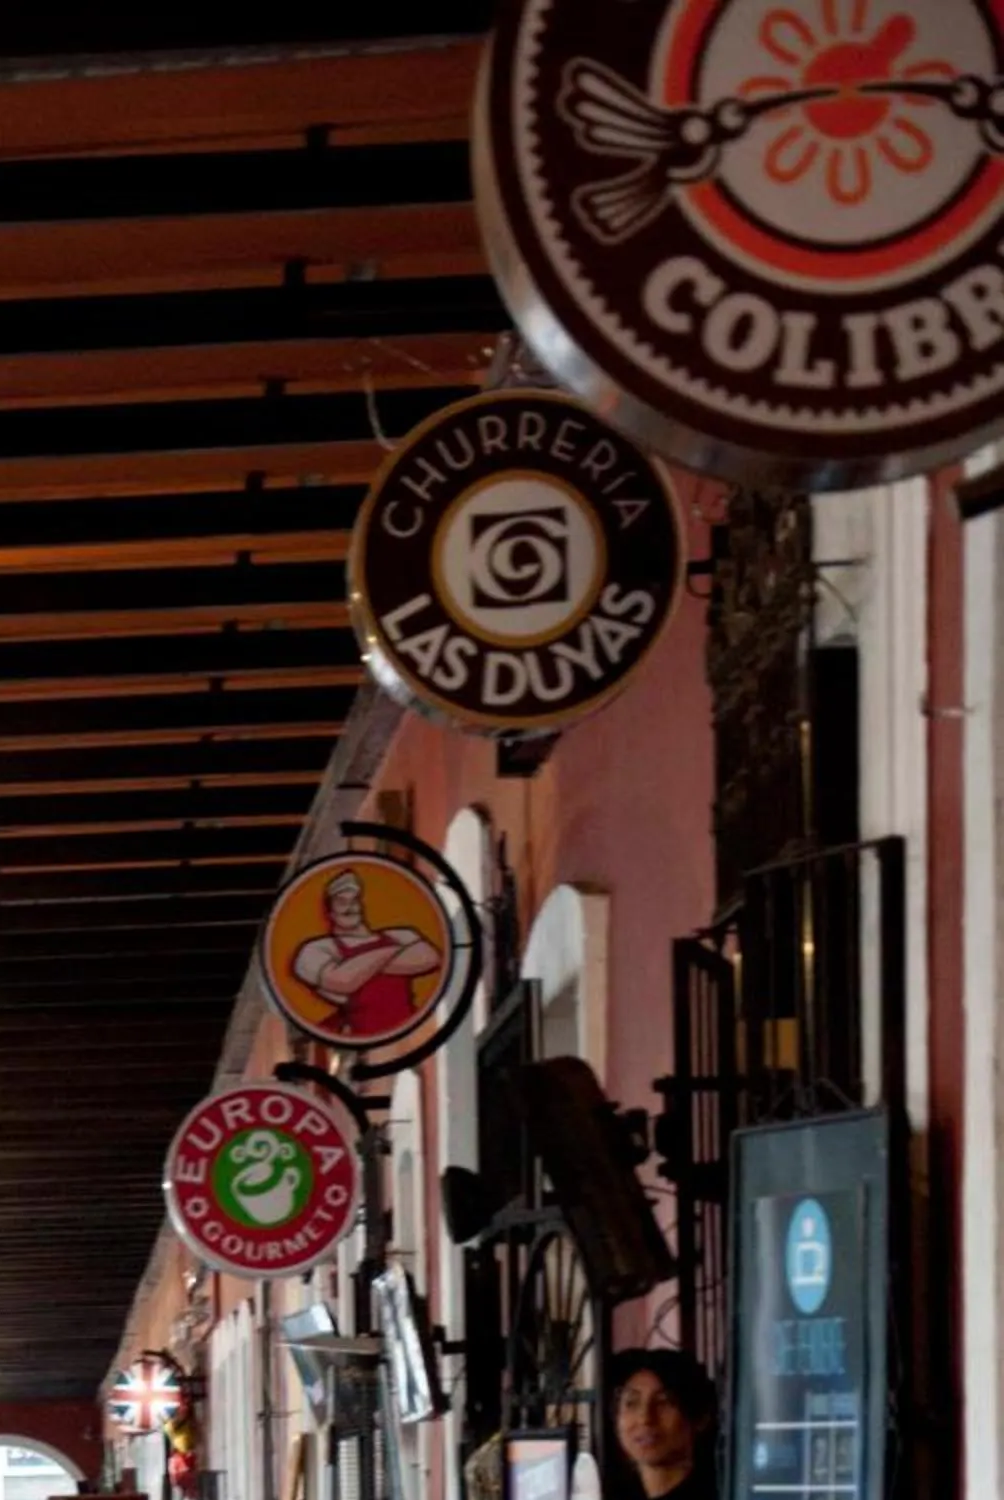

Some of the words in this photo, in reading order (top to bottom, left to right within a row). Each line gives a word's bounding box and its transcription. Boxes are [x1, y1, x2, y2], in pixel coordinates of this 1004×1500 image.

[643, 238, 1004, 389] COLIBR
[380, 594, 478, 691] LAS
[482, 583, 656, 706] DUYAS
[176, 1097, 344, 1184] EUROPA
